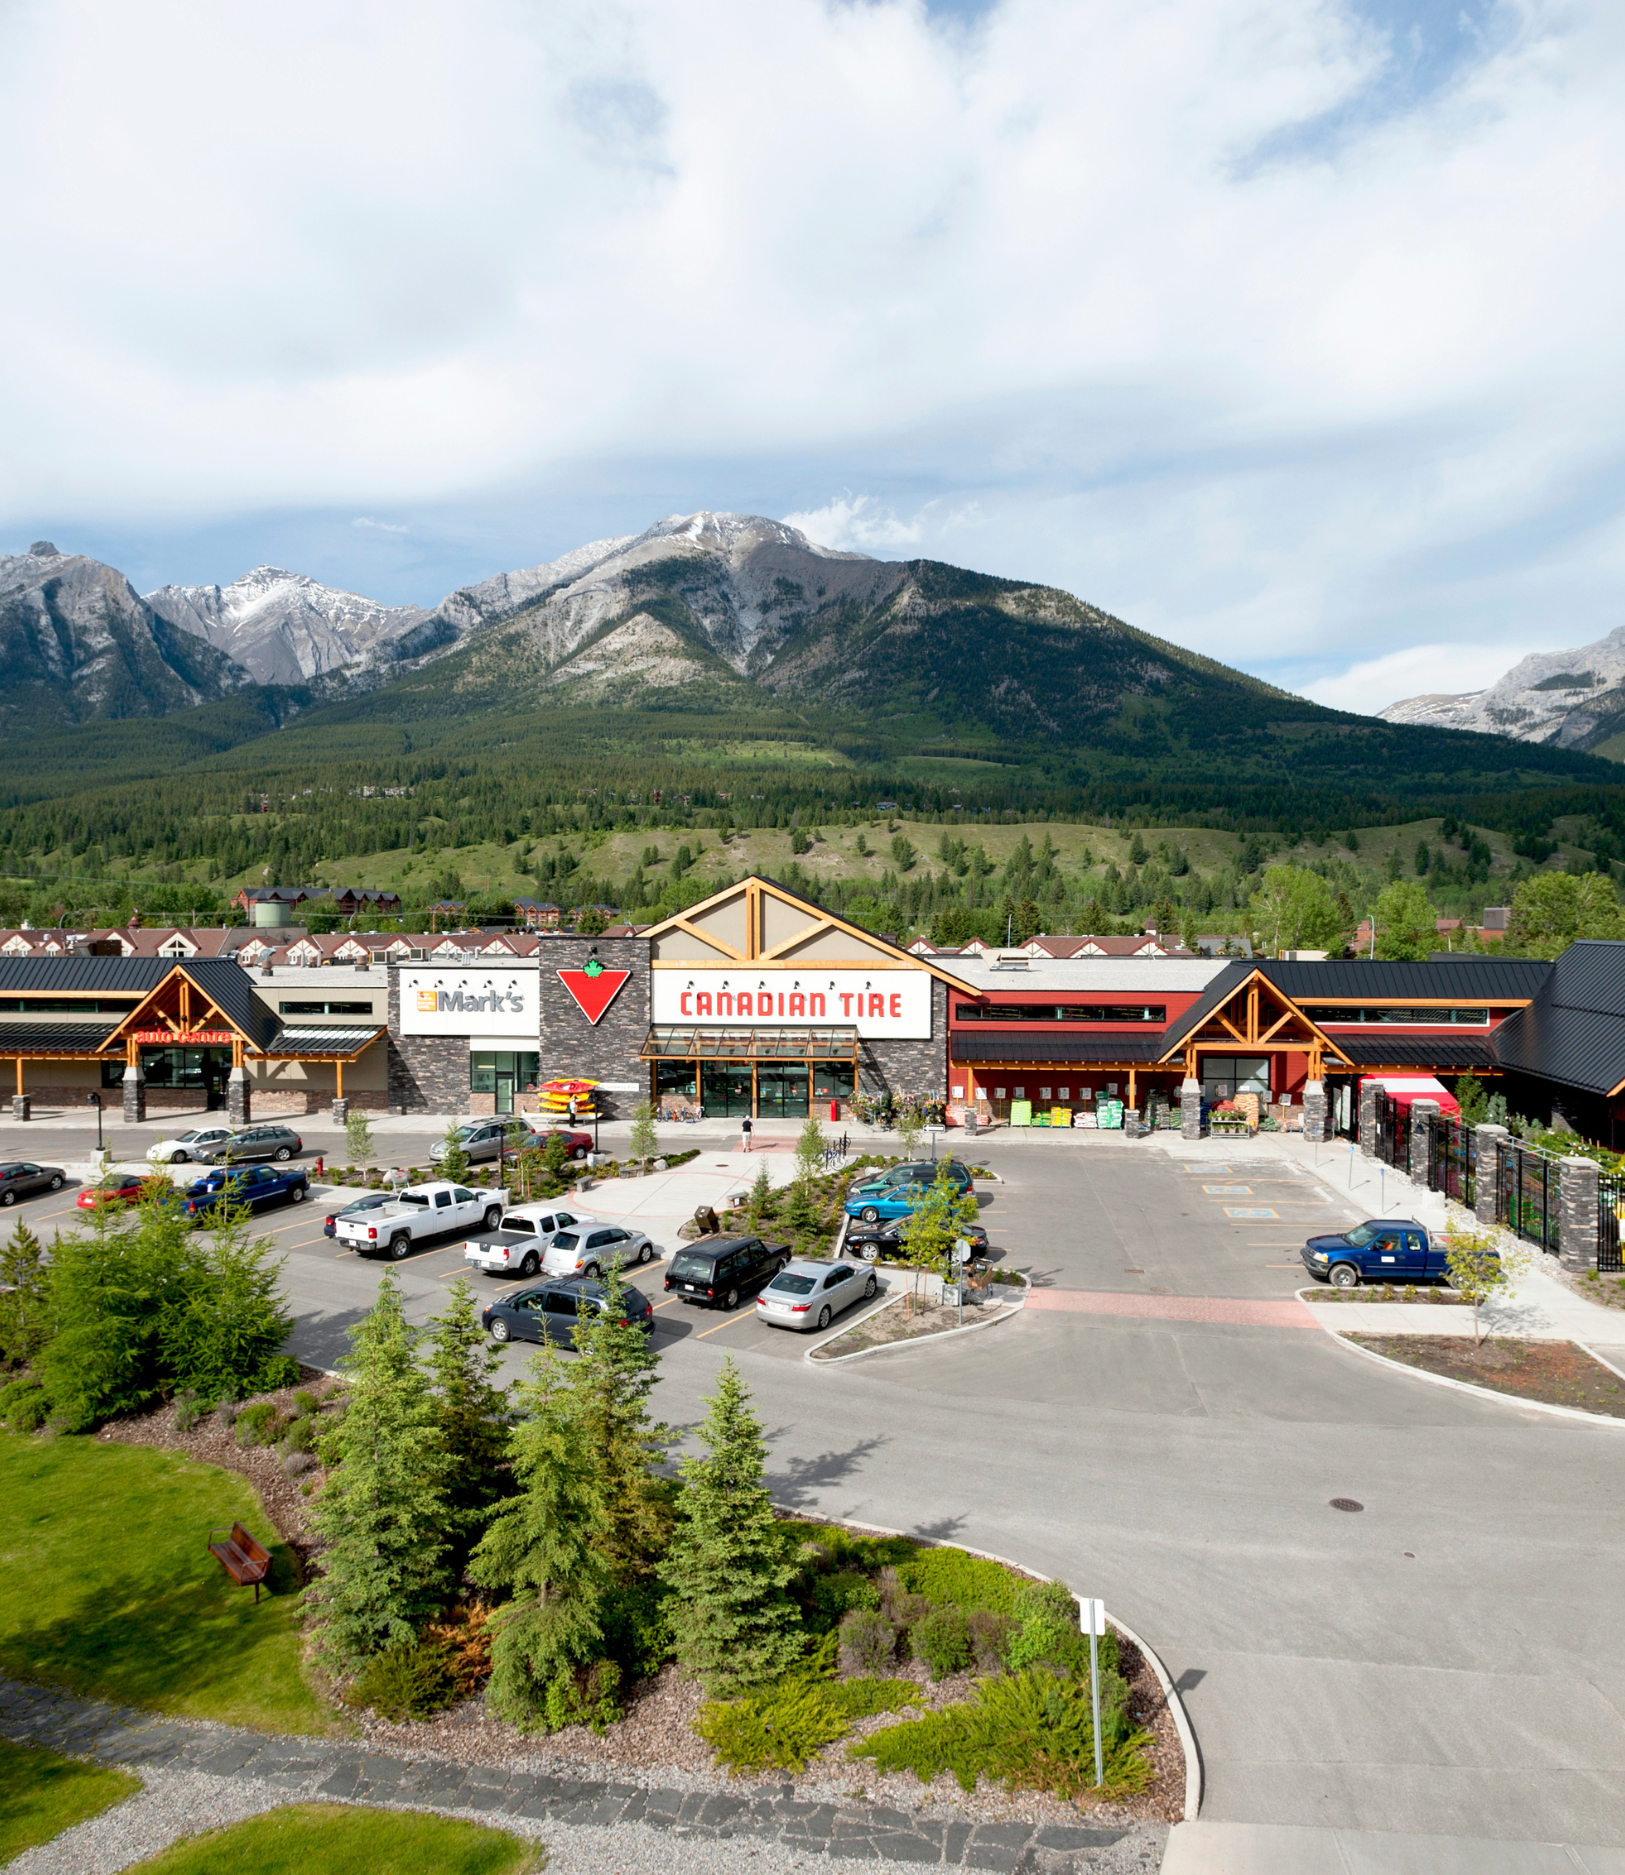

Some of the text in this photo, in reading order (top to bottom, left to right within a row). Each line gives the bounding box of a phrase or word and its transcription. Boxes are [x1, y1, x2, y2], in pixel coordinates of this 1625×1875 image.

[438, 989, 524, 1012] Mark's
[680, 992, 902, 1018] CANADIAN TIRE
[135, 1028, 232, 1044] auto centre
